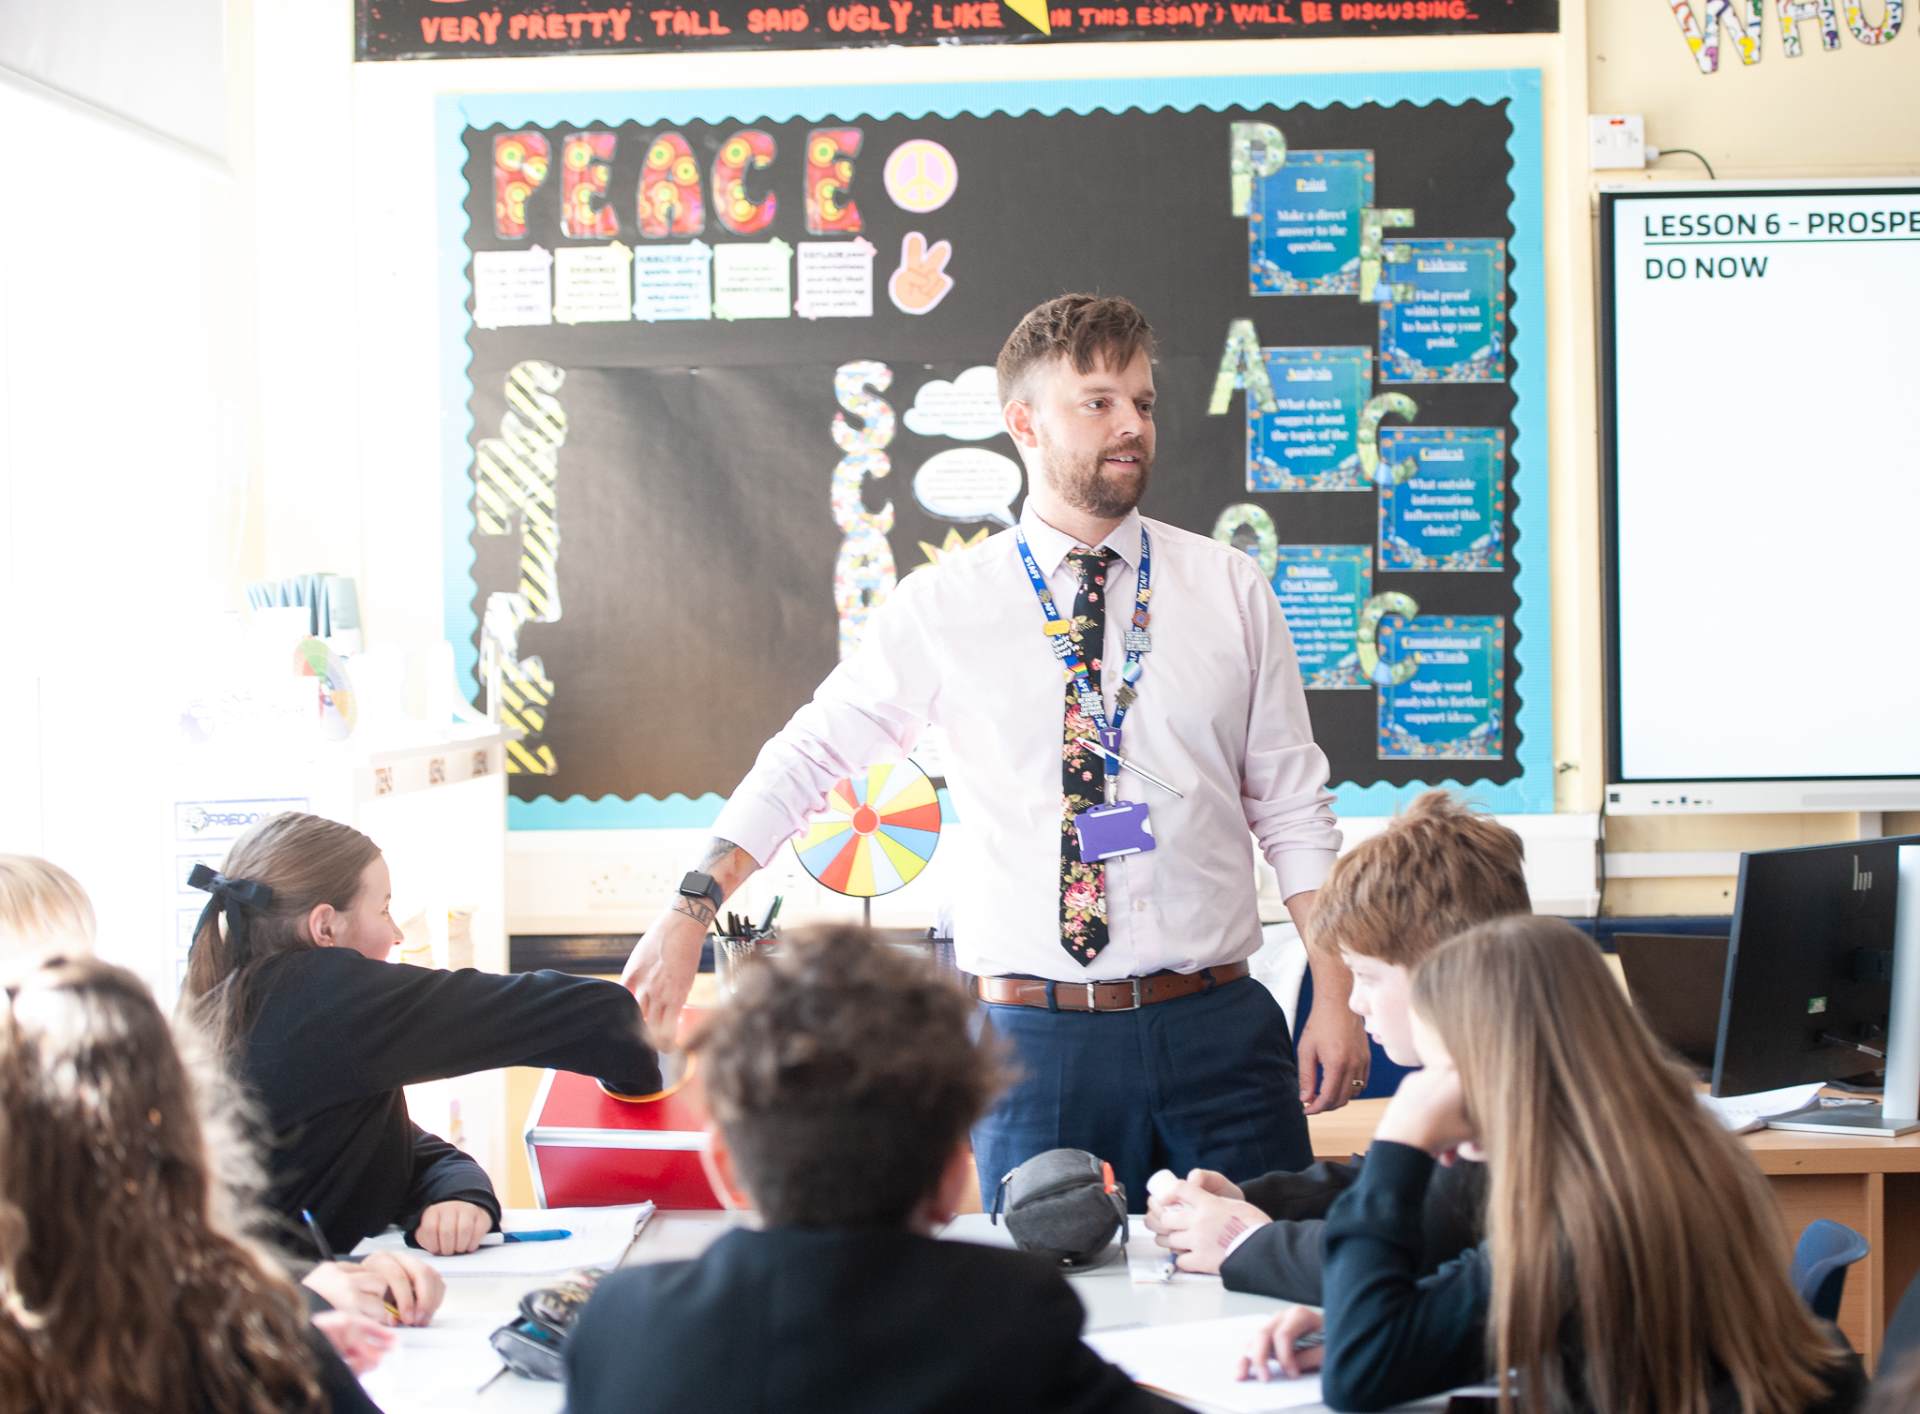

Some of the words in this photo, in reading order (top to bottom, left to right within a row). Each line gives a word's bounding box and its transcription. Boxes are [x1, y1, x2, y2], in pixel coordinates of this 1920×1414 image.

[421, 11, 502, 45] VERY
[509, 8, 631, 42] PRETTY
[650, 8, 731, 37] TALL
[747, 5, 808, 33] SAID
[827, 1, 912, 34] UGLY
[932, 2, 1003, 30] LIKE
[1050, 7, 1072, 27] IN
[1078, 7, 1129, 27] THIS
[1231, 3, 1294, 24] WILL
[1301, 1, 1333, 24] BE
[492, 127, 864, 239] PEACE
[1644, 213, 1756, 237] LESSON
[1765, 213, 1780, 234] 6
[1808, 211, 1920, 234] PROSPE
[1645, 258, 1686, 280] DO
[1696, 256, 1769, 279] NOW
[1024, 555, 1041, 580] STAFF
